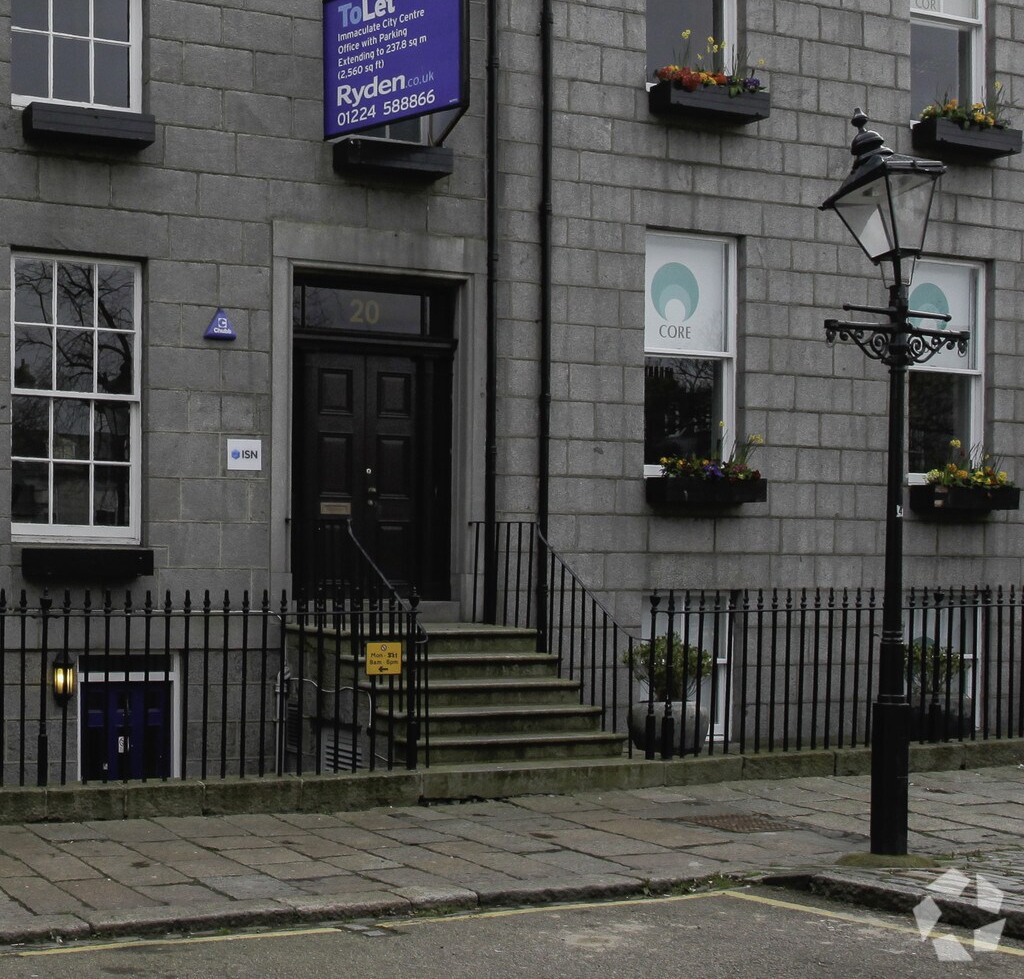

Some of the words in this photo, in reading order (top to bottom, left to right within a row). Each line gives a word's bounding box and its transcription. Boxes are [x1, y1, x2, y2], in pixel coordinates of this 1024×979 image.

[338, 23, 381, 42] Immaculate
[382, 18, 398, 29] City
[399, 9, 425, 23] Centre
[338, 41, 360, 55] Office
[361, 34, 377, 48] with
[379, 27, 408, 43] Parking
[338, 50, 375, 67] Extending
[376, 47, 385, 56] to
[386, 39, 407, 54] 237.8
[408, 37, 418, 47] sq
[419, 35, 427, 43] m
[337, 64, 363, 80] (2,560
[365, 63, 374, 72] sq
[375, 59, 385, 69] ft)
[337, 70, 435, 108] Ryden.co.uk
[337, 104, 376, 126] 01224
[383, 89, 436, 116] 588866
[350, 299, 380, 324] 20
[659, 324, 692, 340] CORE
[241, 450, 258, 460] ISN
